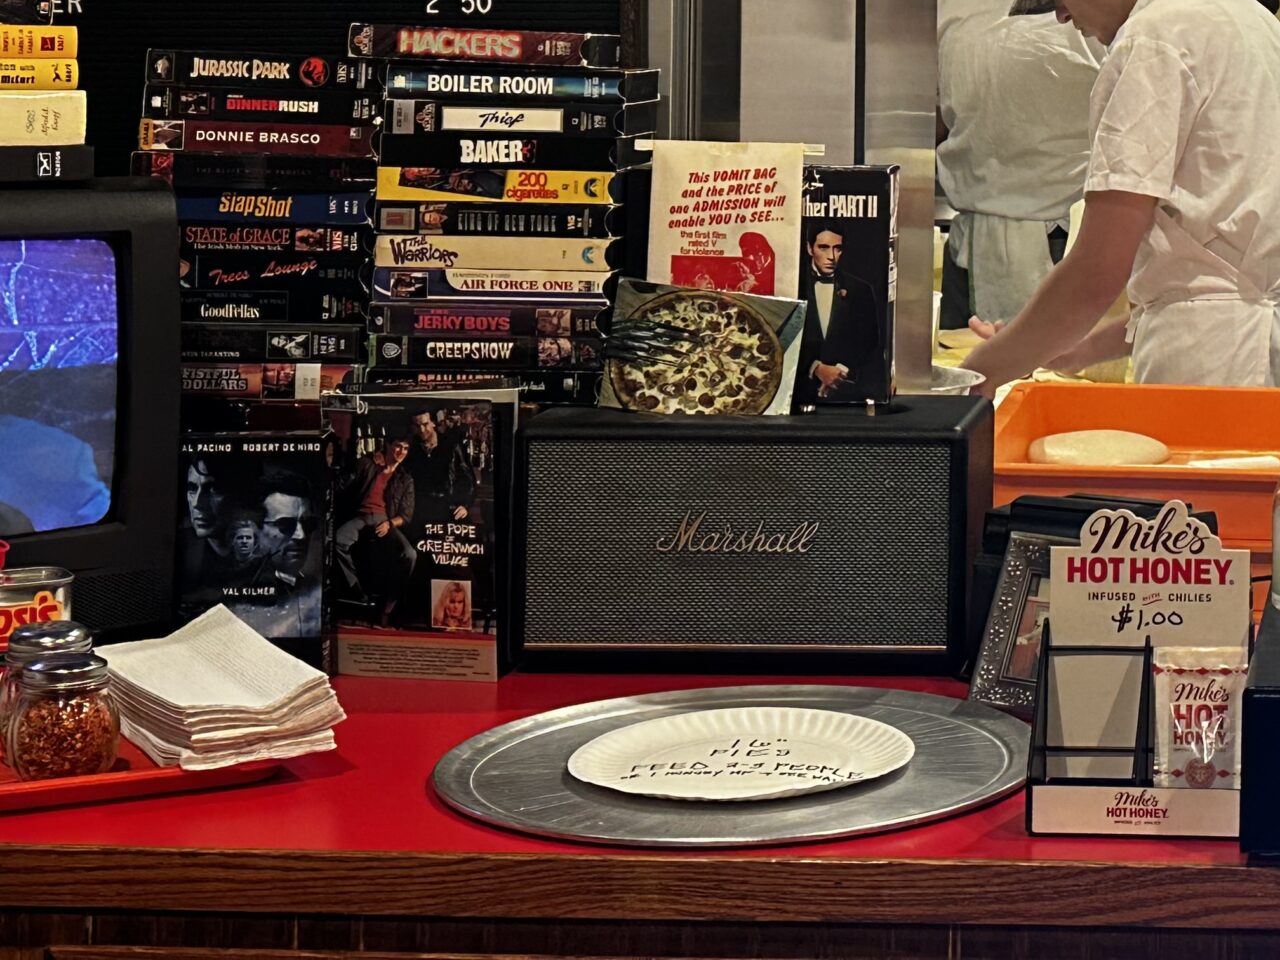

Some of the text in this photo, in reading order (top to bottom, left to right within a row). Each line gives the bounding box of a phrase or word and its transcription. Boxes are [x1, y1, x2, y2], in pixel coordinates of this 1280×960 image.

[399, 30, 521, 57] HACKERS
[190, 58, 290, 80] JURASSIC PARK
[427, 74, 553, 95] BOILER ROOM
[478, 111, 525, 128] Thief
[196, 130, 320, 144] DONNIE BRASCO
[460, 139, 523, 163] BAKER
[518, 172, 548, 188] 200
[688, 167, 777, 184] This VOMIT BAG
[681, 181, 778, 198] and the PRICE of
[219, 192, 293, 218] Slap Shot
[669, 195, 786, 215] one ADMISSION will
[829, 195, 865, 218] PART
[867, 197, 878, 218] II
[668, 210, 785, 229] enable YOU to SEE...
[186, 227, 290, 244] STATE of GRACE
[209, 258, 318, 287] Trees Lounge
[460, 280, 574, 291] AIR FORCE ONE
[415, 315, 511, 331] JERKY BOYS
[426, 342, 514, 359] CREEPSHOW
[182, 368, 240, 380] FISTFUL
[181, 379, 247, 391] DOLLARS
[182, 444, 232, 452] AL PACINO
[242, 444, 281, 452] ROBERT
[282, 444, 296, 452] DE
[425, 523, 476, 537] THE POPE
[656, 510, 821, 552] Marshall
[1089, 506, 1207, 555] Mike's
[417, 540, 484, 555] GREENWICH
[1067, 557, 1125, 584] HOT
[242, 587, 276, 596] KILMER
[1088, 592, 1136, 602] INFUSED
[1168, 593, 1212, 603] CHILIES
[1112, 603, 1184, 633] $1.00
[1173, 678, 1232, 703] Mike's
[1173, 703, 1229, 730] HOT
[629, 761, 709, 773] FEED
[1114, 790, 1160, 808] Mike's
[1106, 807, 1168, 819] HOT HONEY
